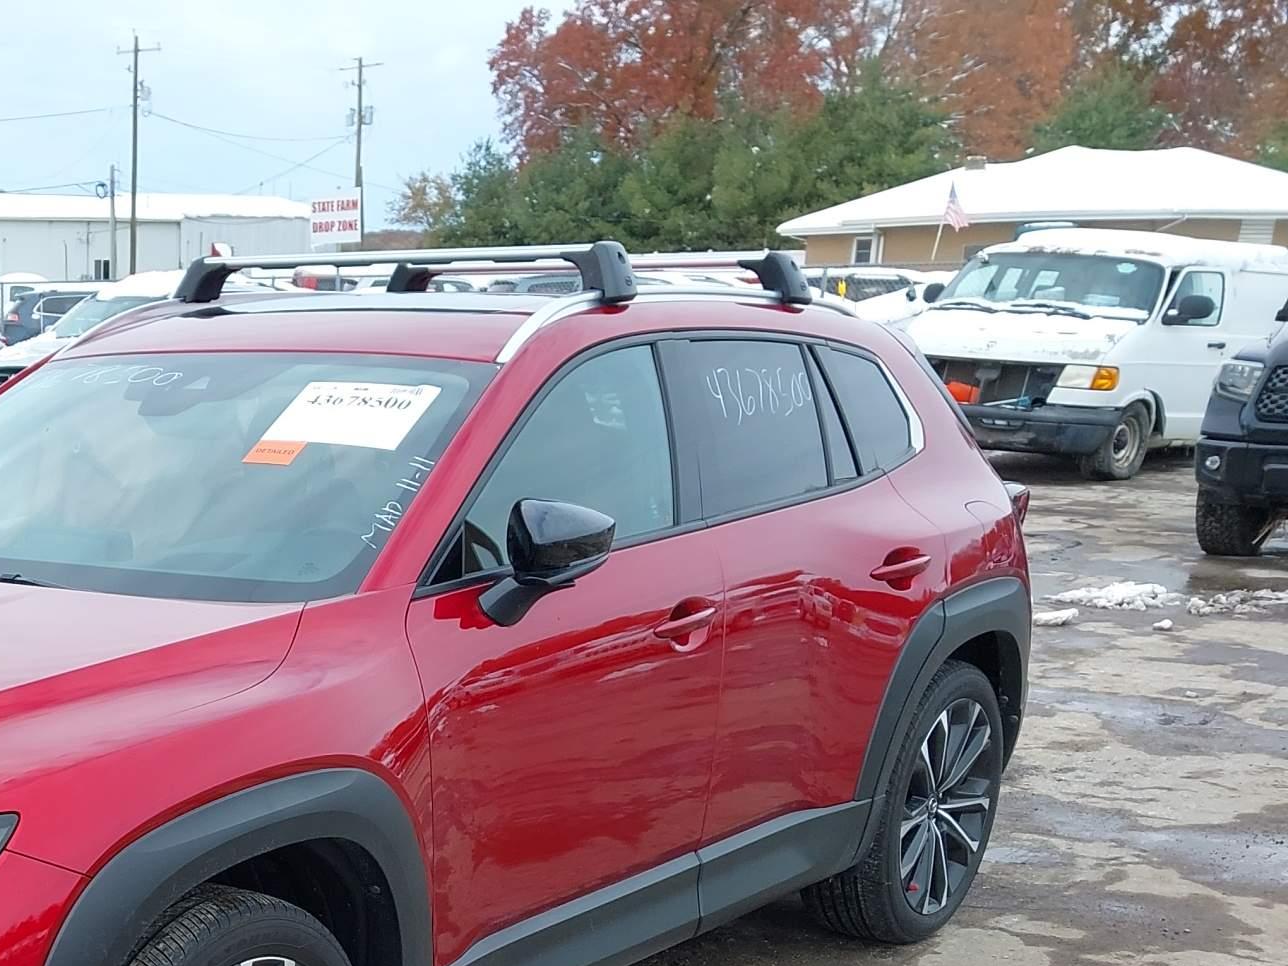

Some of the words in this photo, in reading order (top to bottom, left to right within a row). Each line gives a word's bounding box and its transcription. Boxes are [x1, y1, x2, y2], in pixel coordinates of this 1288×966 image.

[312, 200, 334, 213] STATE
[337, 198, 358, 211] FARM
[312, 221, 335, 233] DROP
[338, 219, 358, 231] ZONE
[706, 367, 812, 426] 43678500
